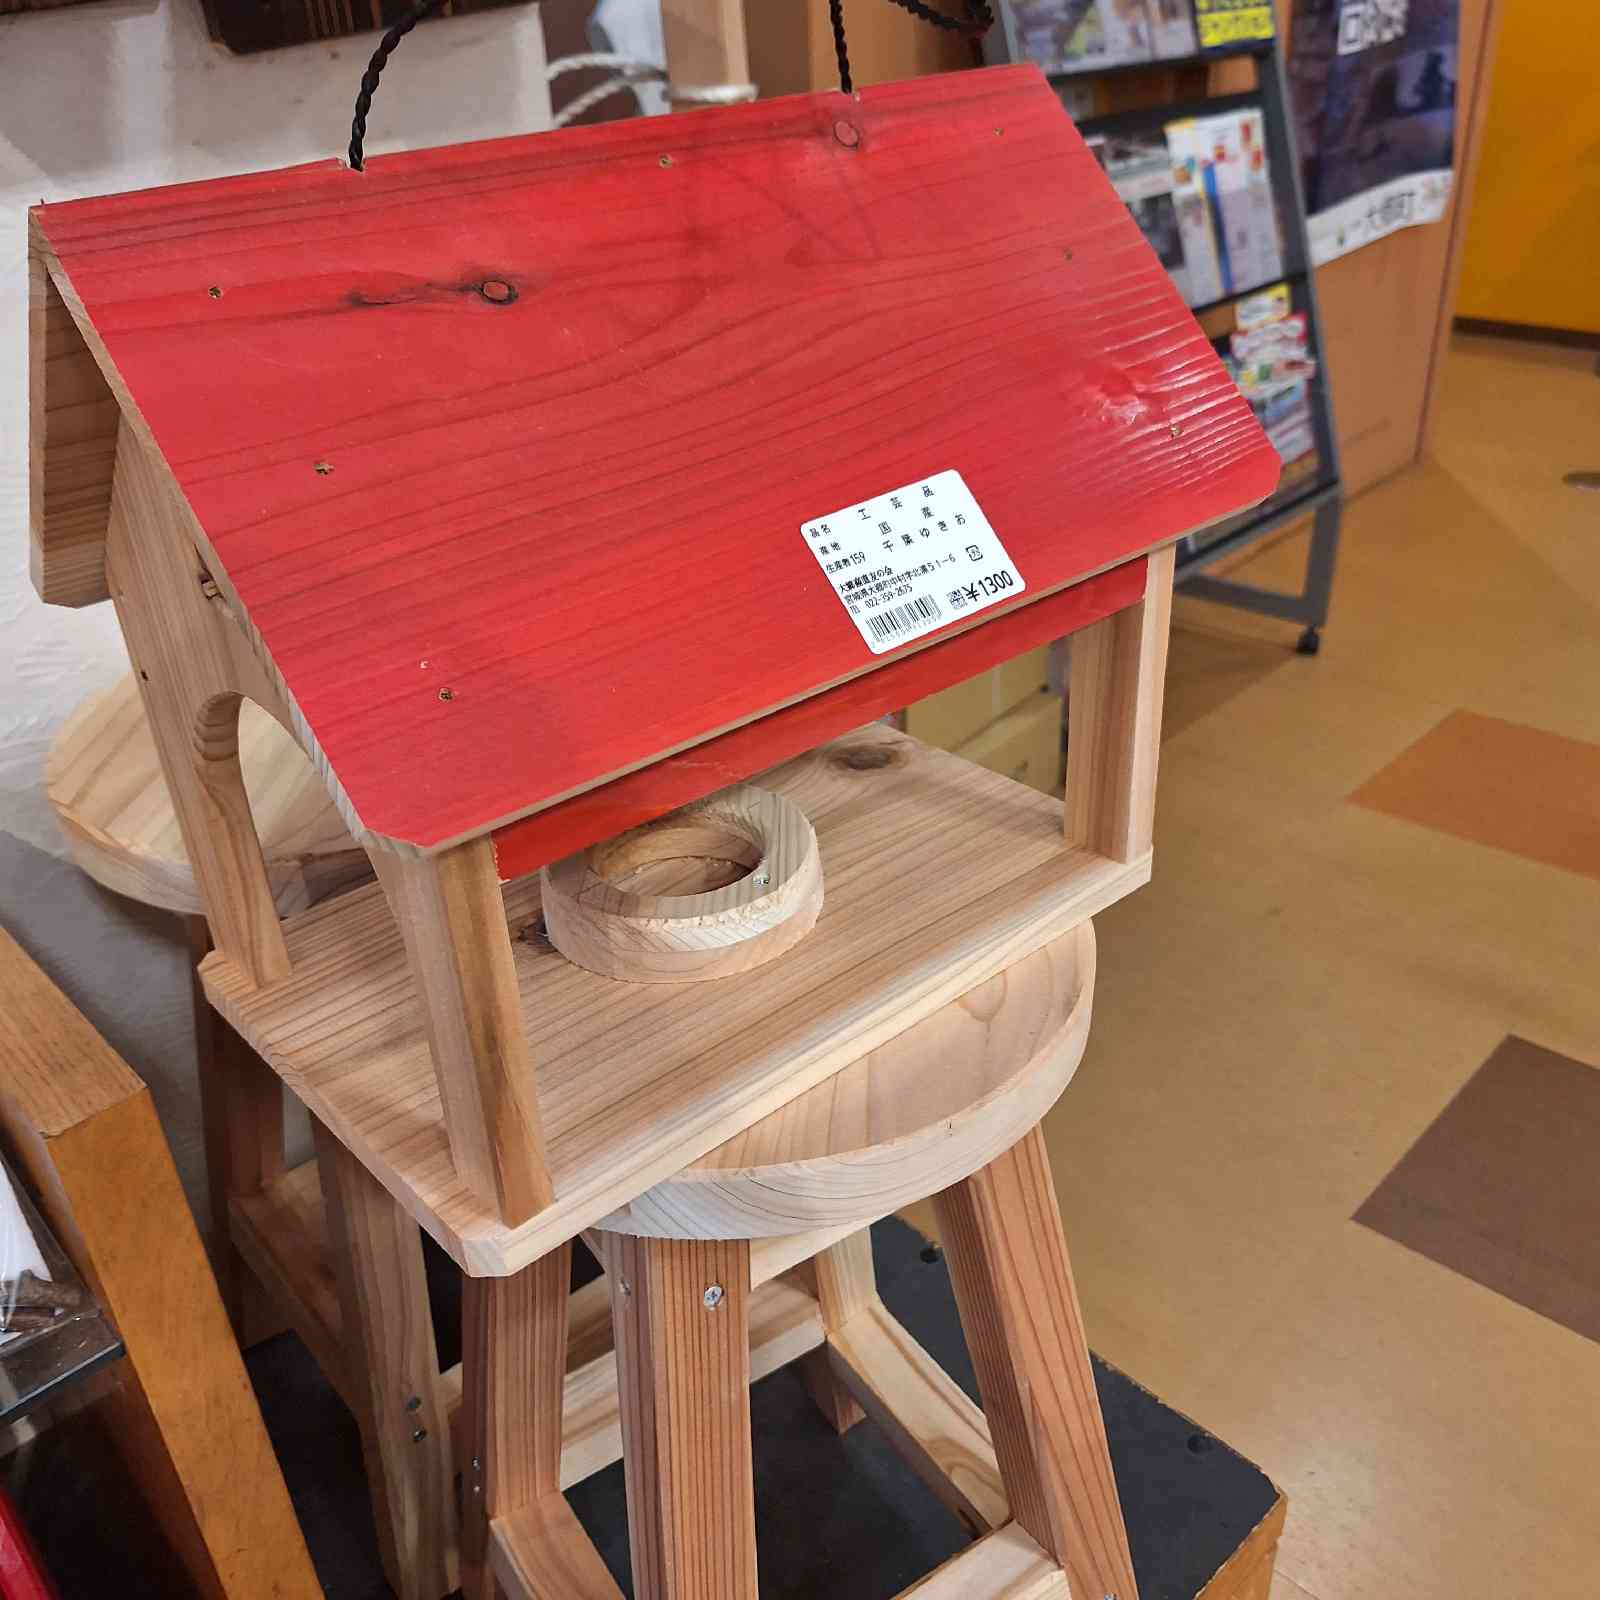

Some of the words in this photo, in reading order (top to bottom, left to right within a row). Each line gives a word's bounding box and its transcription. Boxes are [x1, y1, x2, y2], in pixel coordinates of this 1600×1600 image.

[858, 485, 934, 520] 工芸品
[961, 570, 1014, 602] ¥1300
